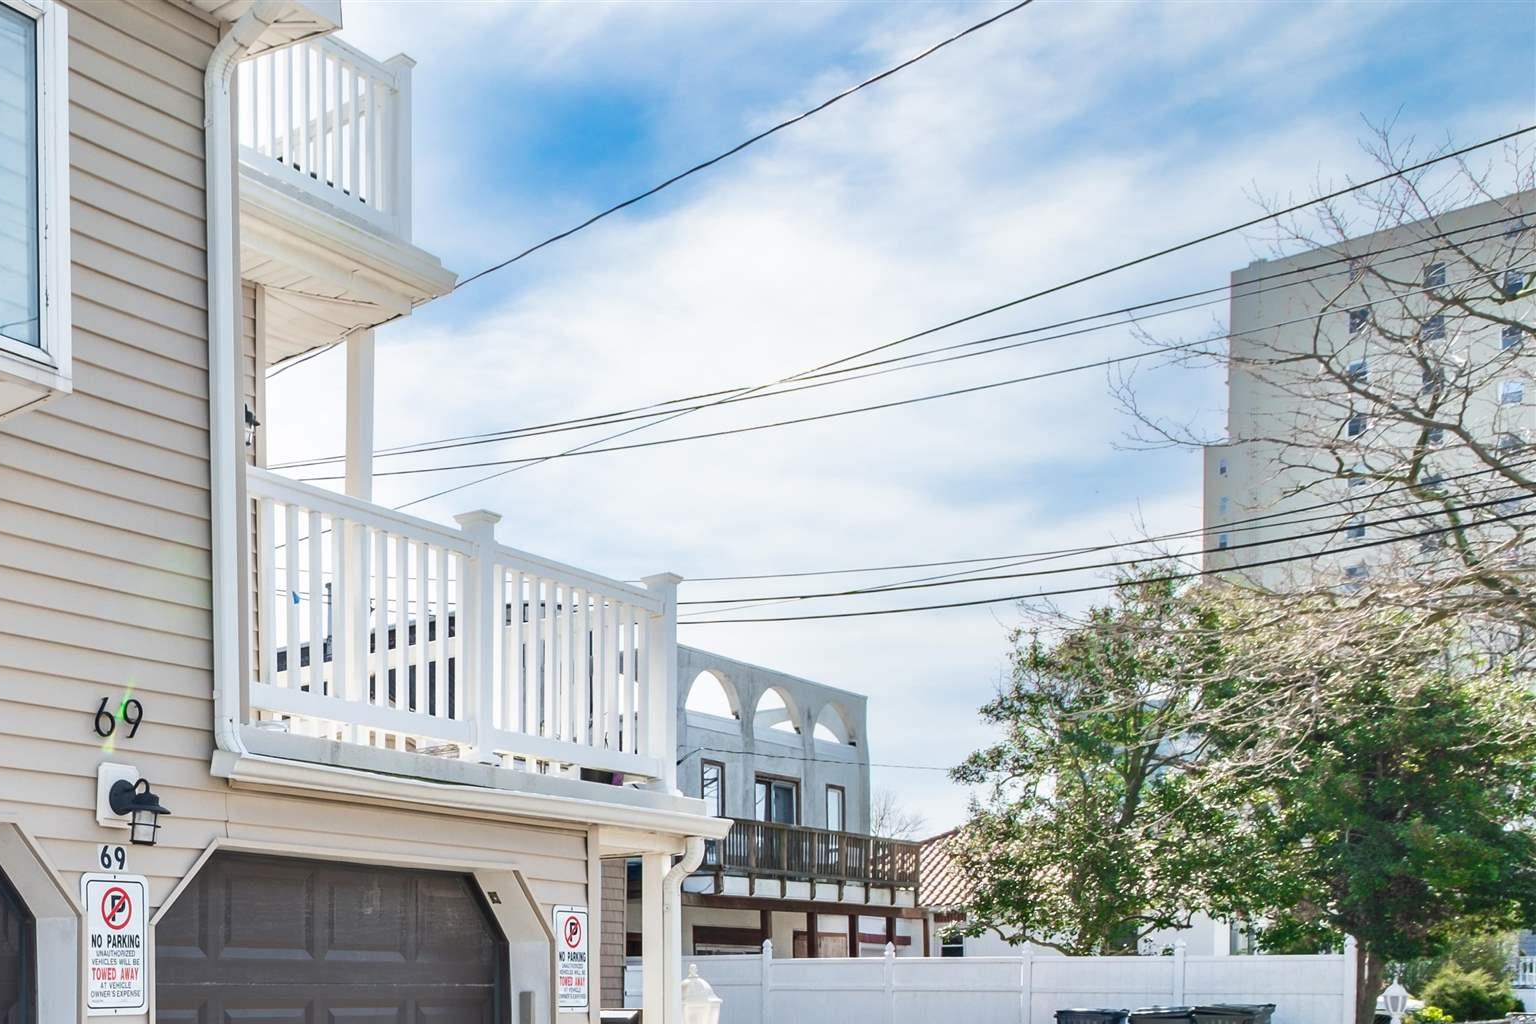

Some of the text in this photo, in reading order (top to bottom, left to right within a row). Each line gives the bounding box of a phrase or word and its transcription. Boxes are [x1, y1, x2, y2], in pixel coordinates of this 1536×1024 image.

[94, 697, 144, 738] 69
[100, 845, 126, 870] 69
[91, 934, 140, 948] NO PARKING
[92, 958, 117, 966] VEHICLES
[567, 952, 586, 962] PARKING
[92, 967, 139, 980] TOWED AWAY
